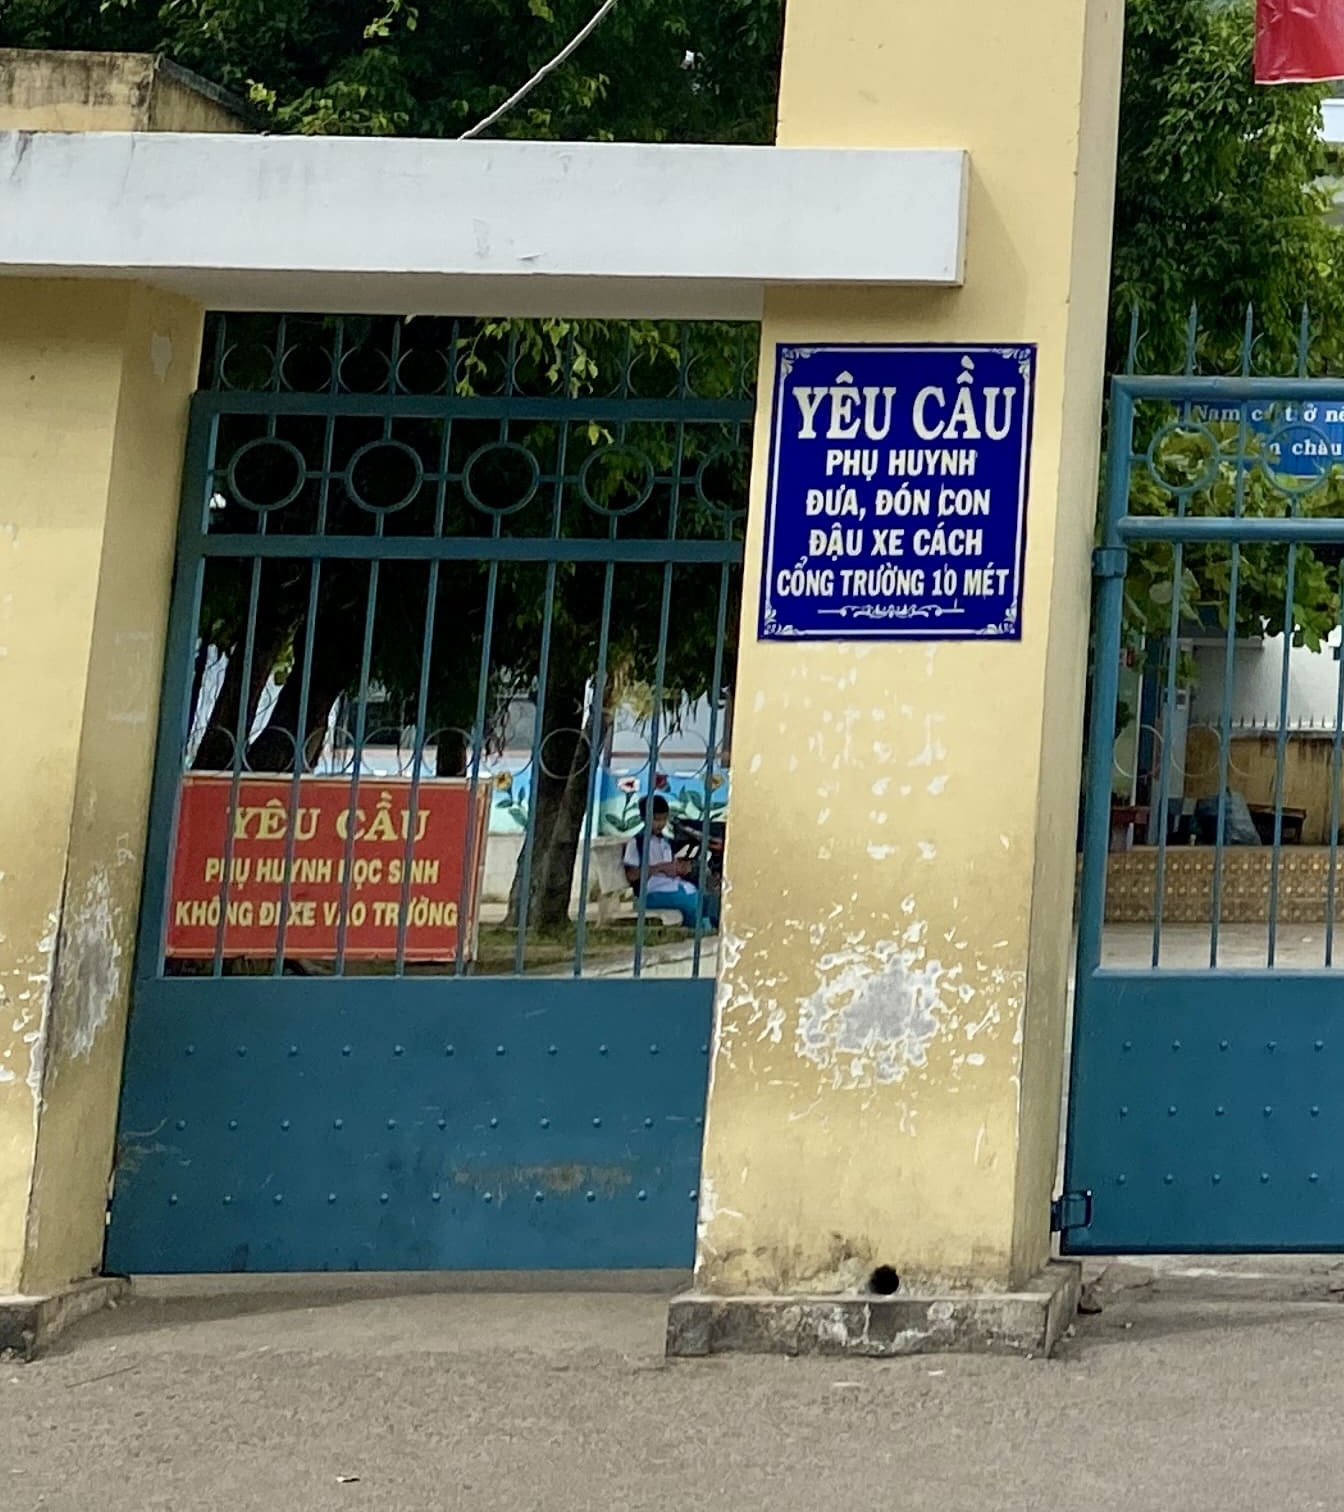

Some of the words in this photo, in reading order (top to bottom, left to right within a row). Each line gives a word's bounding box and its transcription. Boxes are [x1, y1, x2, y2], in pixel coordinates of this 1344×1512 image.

[792, 371, 896, 440] YÊU
[912, 355, 1016, 440] CẦU
[1285, 402, 1318, 422] tở
[826, 449, 878, 480] PHỤ
[888, 449, 977, 476] HUYNH
[806, 484, 866, 521] ĐƯA,
[875, 481, 930, 516] ĐÓN
[939, 488, 990, 516] CON
[809, 522, 863, 561] ĐẬU
[871, 529, 904, 556] XE
[913, 522, 983, 556] CÁCH
[777, 556, 834, 597] CỔNG
[840, 563, 924, 597] TRƯỜNG
[932, 568, 957, 596] 10
[963, 562, 1009, 597] MÉT
[226, 798, 321, 841] YÊU
[336, 791, 431, 841] CẦU
[205, 857, 251, 890] PHỤ
[255, 857, 332, 883] HUYNH
[388, 858, 439, 885] SINH
[175, 894, 254, 927] KHÔNG
[259, 900, 282, 926] ĐI
[286, 901, 317, 926] XE
[372, 895, 459, 927] TRƯỜNG
